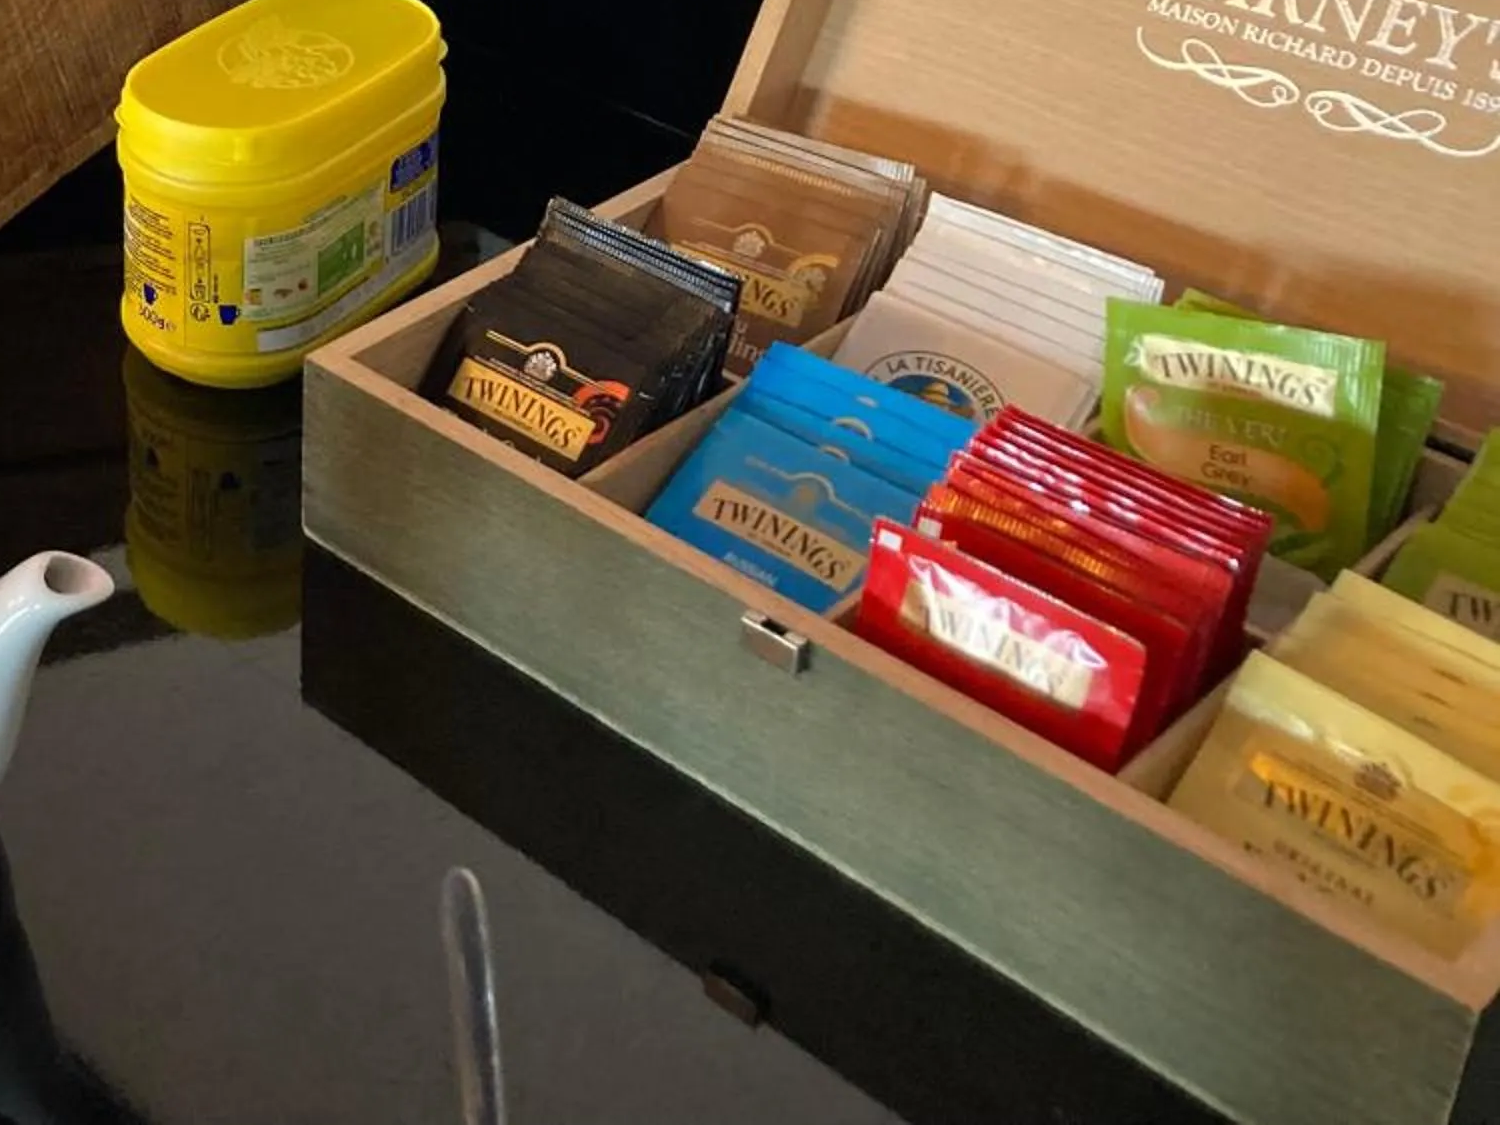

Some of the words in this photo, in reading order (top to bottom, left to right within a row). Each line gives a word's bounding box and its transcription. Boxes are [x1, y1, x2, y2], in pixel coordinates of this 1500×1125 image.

[1242, 23, 1357, 70] RICHARD
[1360, 56, 1458, 101] DEPUIS
[885, 358, 910, 375] LA
[1154, 352, 1323, 407] TWININGS
[463, 375, 578, 449] TWININGS
[1208, 444, 1248, 468] Earl
[712, 496, 846, 581] TWININGS
[1258, 779, 1450, 901] TWININGS
